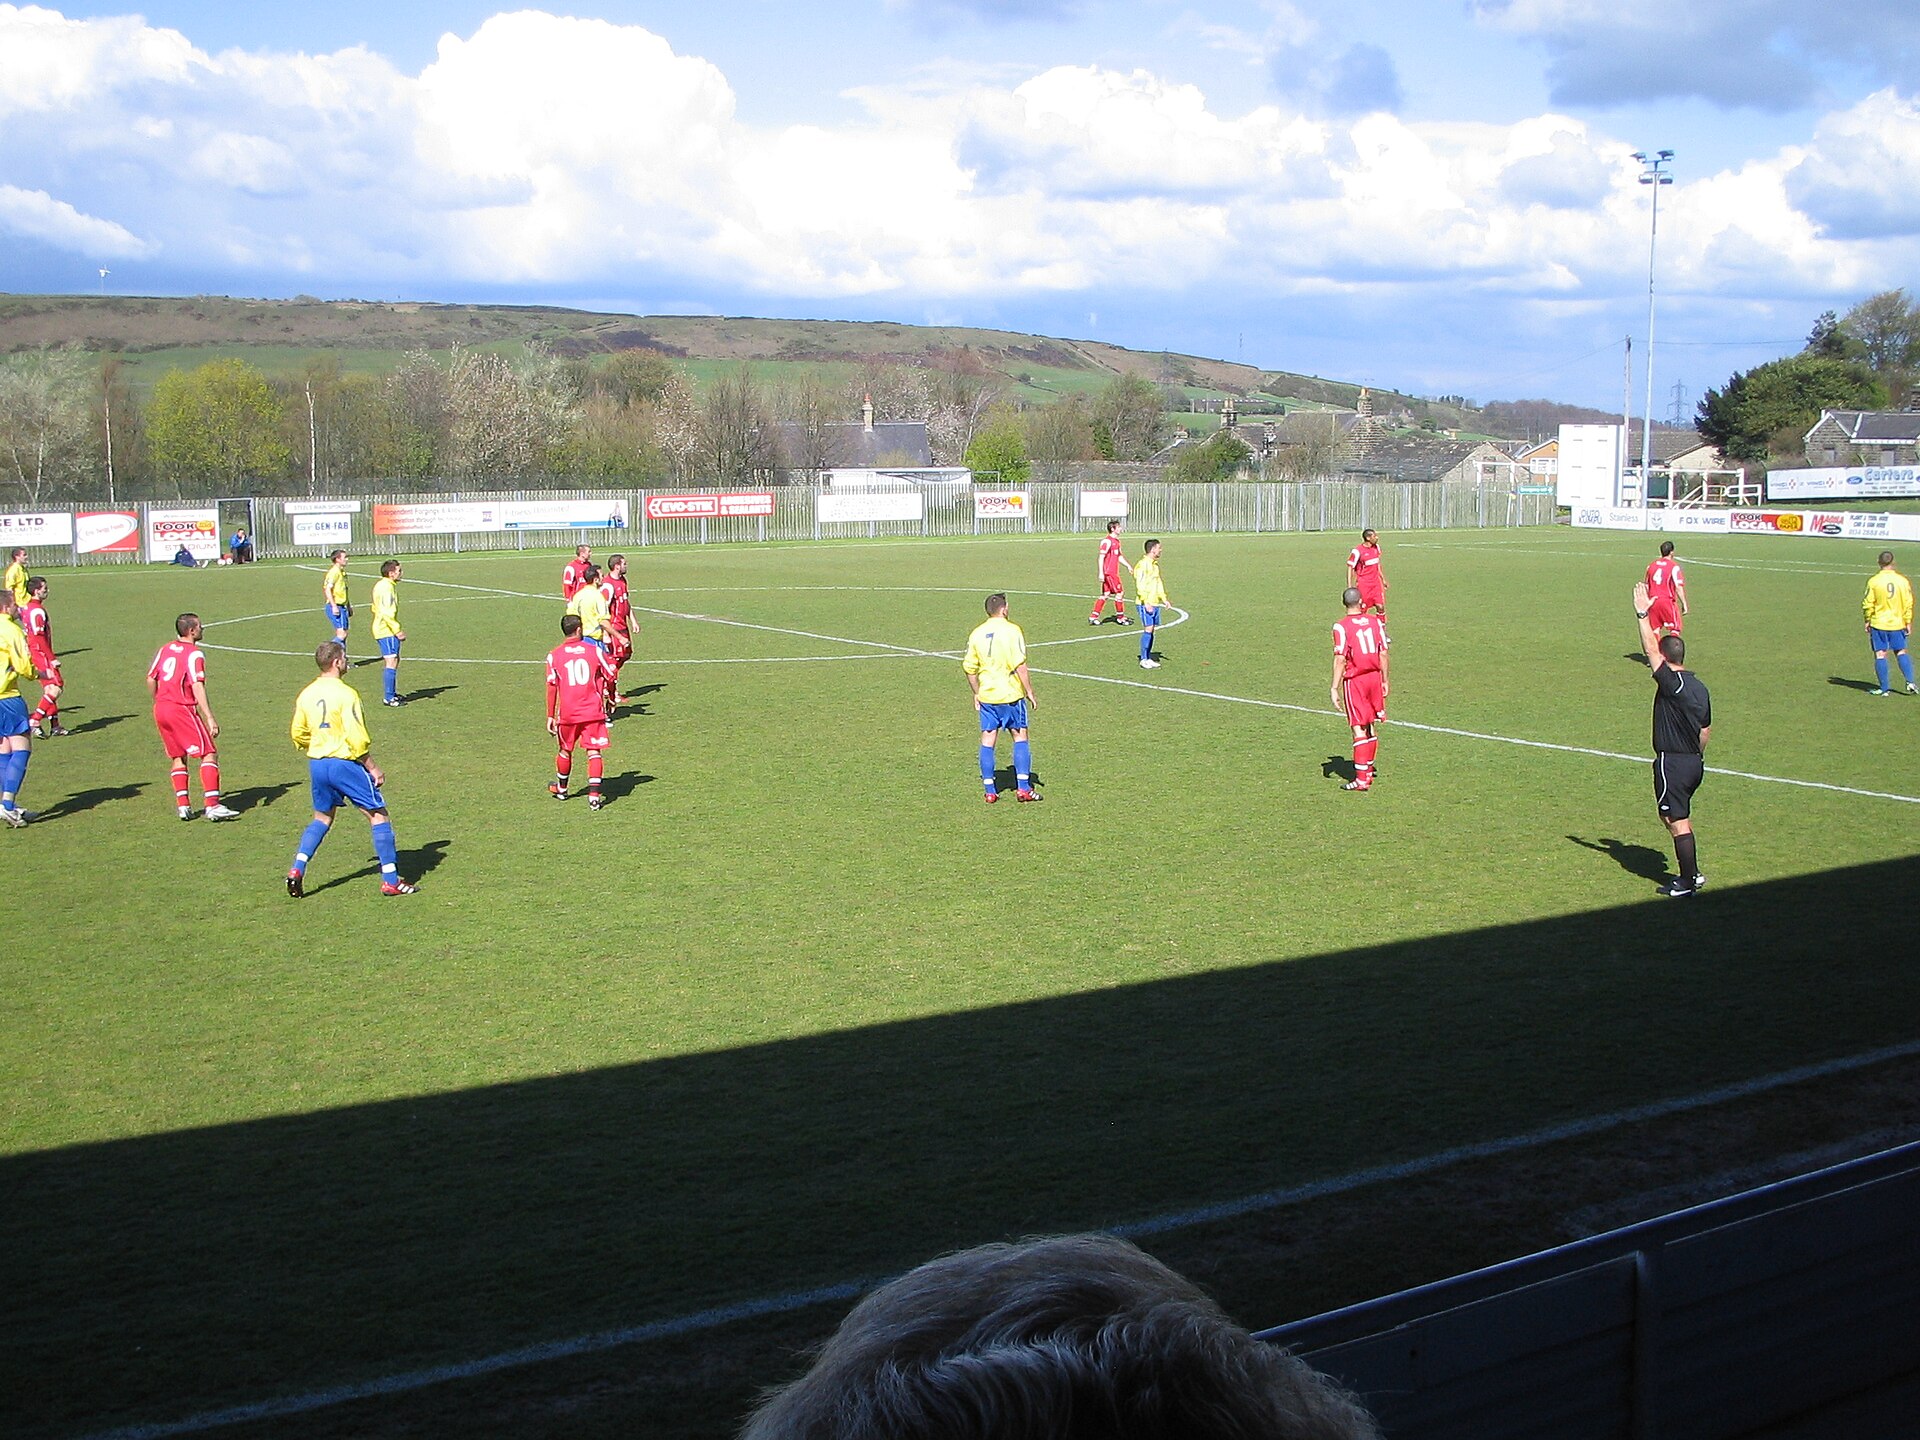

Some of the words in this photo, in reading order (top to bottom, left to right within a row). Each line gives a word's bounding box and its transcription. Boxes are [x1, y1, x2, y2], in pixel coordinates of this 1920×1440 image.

[1865, 468, 1914, 481] Carters
[661, 501, 713, 513] EVO-STIK
[1609, 512, 1639, 523] Stainless
[1679, 517, 1699, 525] FOX
[1702, 517, 1726, 525] WIRE
[155, 523, 194, 531] LOOK
[315, 522, 349, 530] GEN-FAB
[1732, 521, 1775, 530] LOCAL
[154, 531, 216, 540] LOCAL
[165, 543, 217, 551] STDIUM
[1653, 568, 1663, 585] 4
[1887, 582, 1895, 599] 9
[985, 633, 995, 657] 7
[1356, 628, 1376, 654] 11
[162, 656, 177, 681] 9
[564, 658, 590, 686] 10
[316, 699, 331, 728] 2
